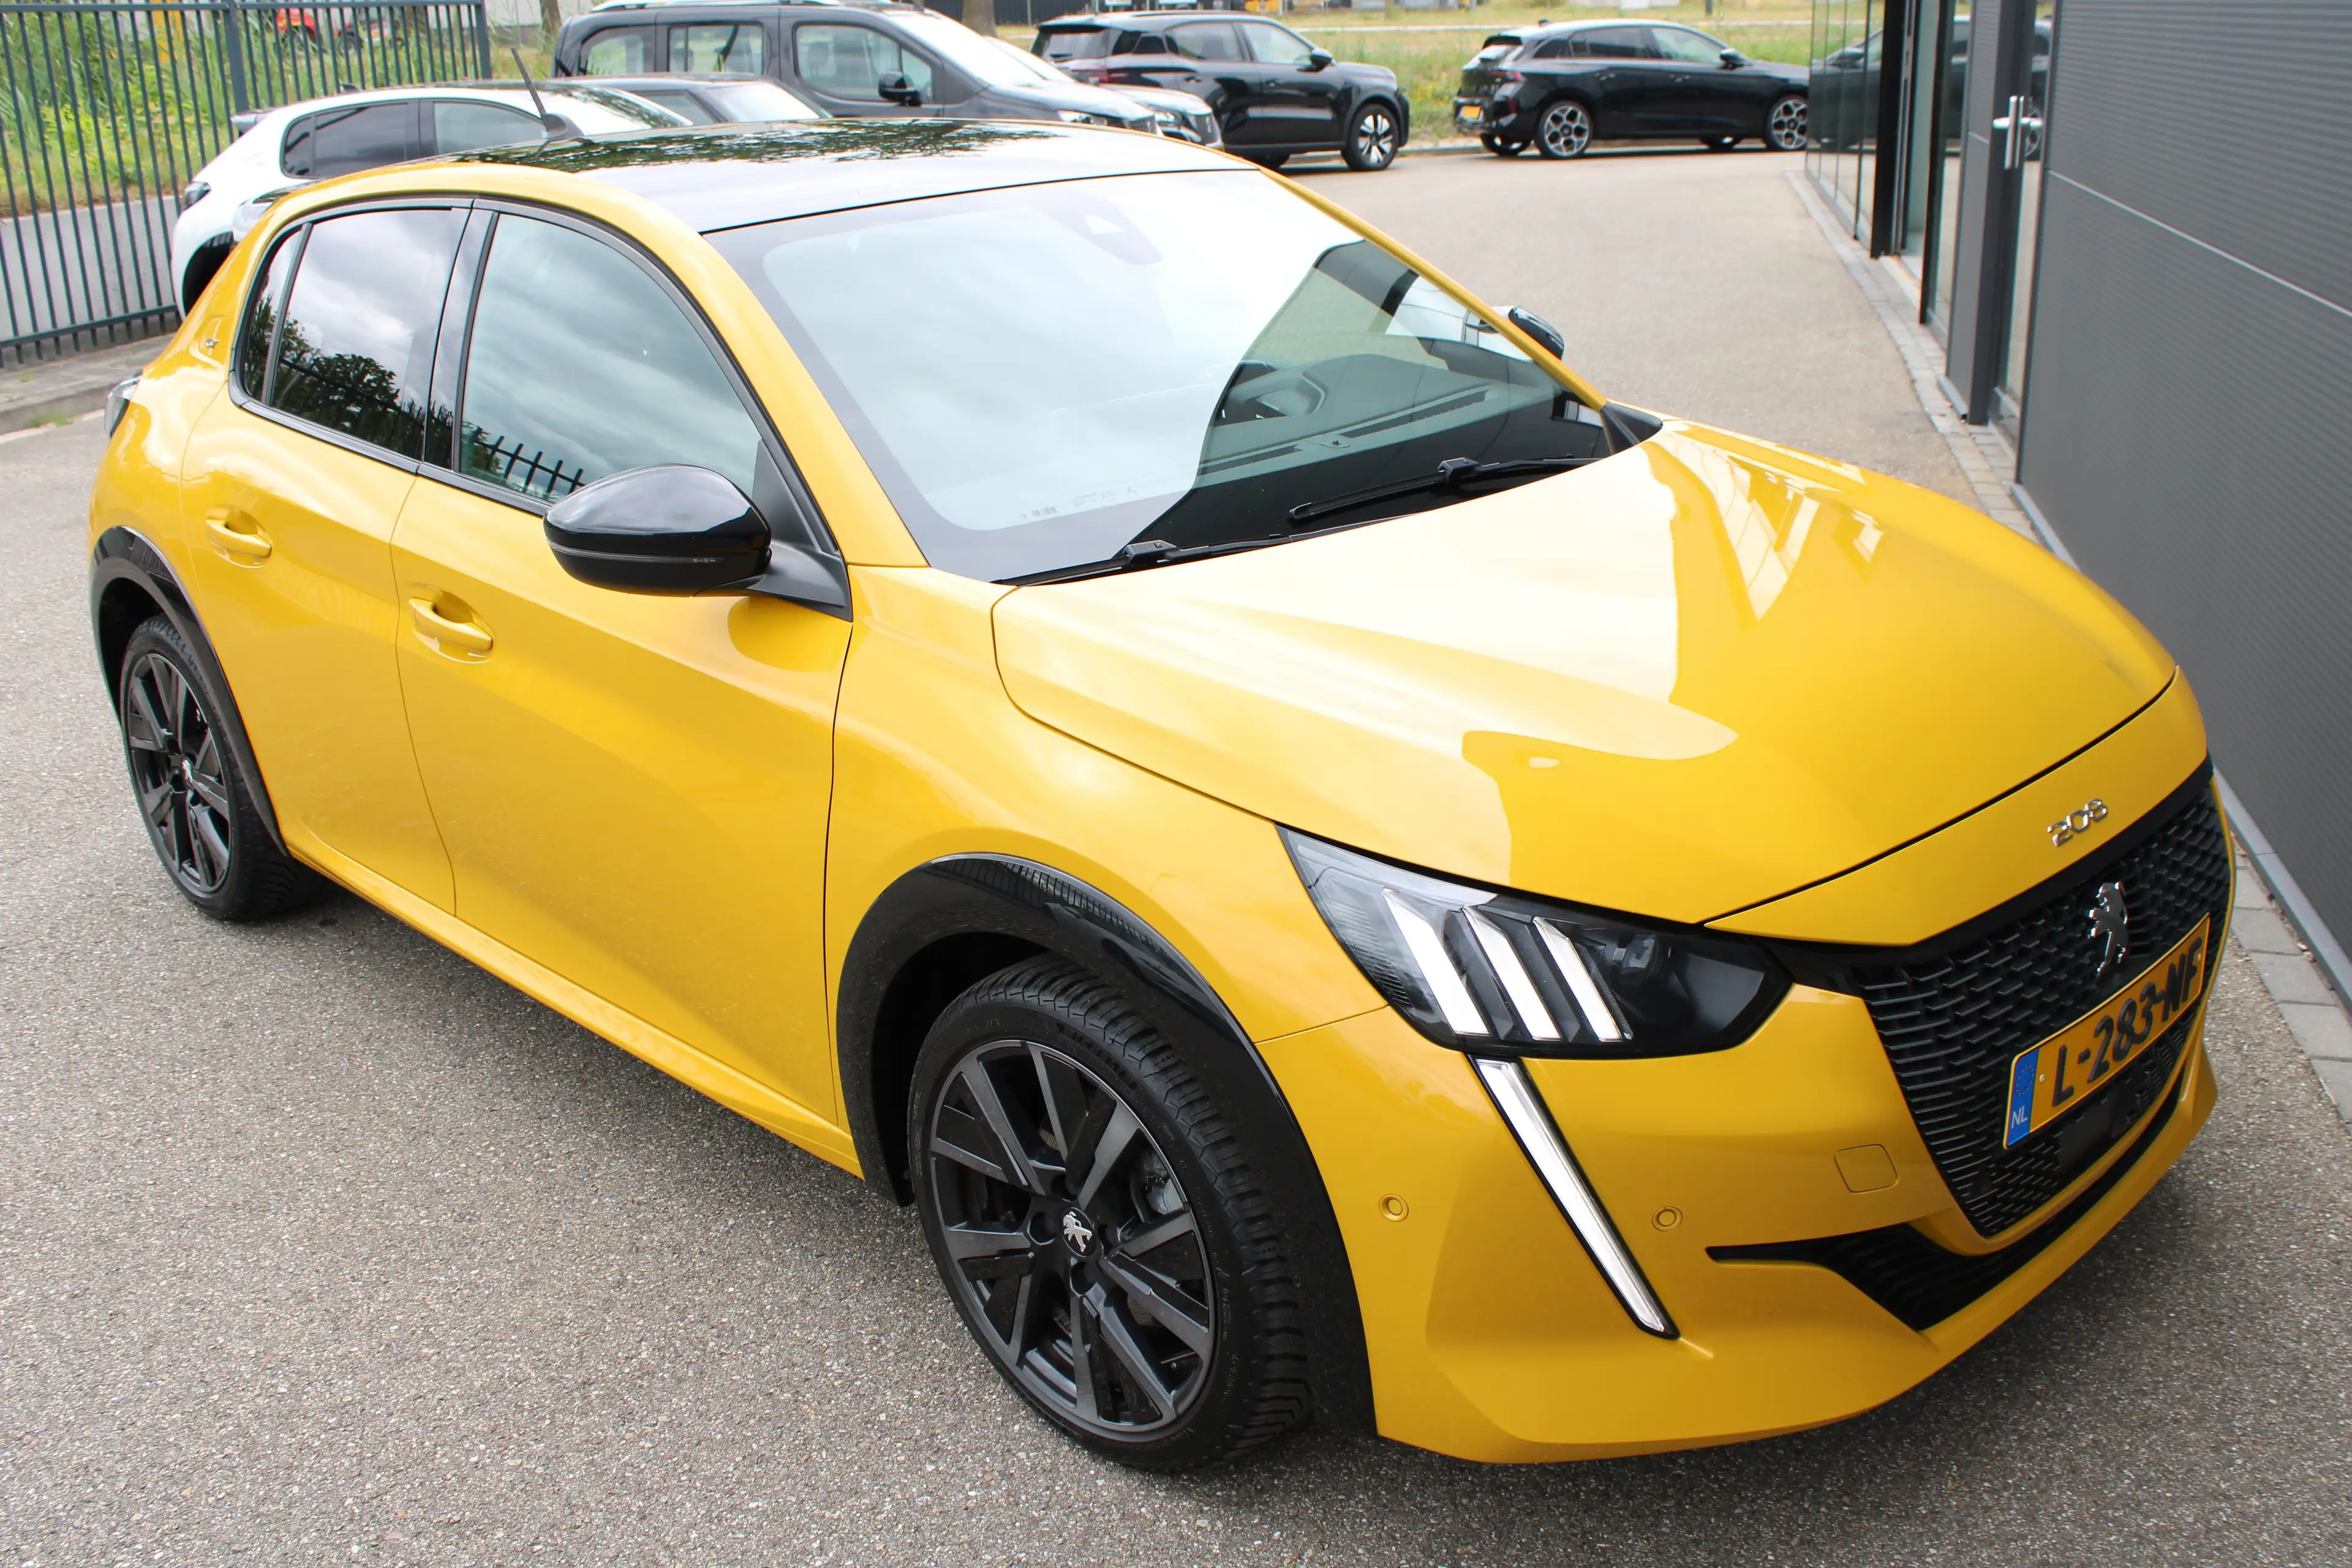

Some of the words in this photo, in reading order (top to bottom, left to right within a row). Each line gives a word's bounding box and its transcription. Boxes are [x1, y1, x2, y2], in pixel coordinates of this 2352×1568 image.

[2046, 798, 2108, 847] 208
[2052, 937, 2203, 1107] L-283-NF
[2011, 1105, 2028, 1129] NL
